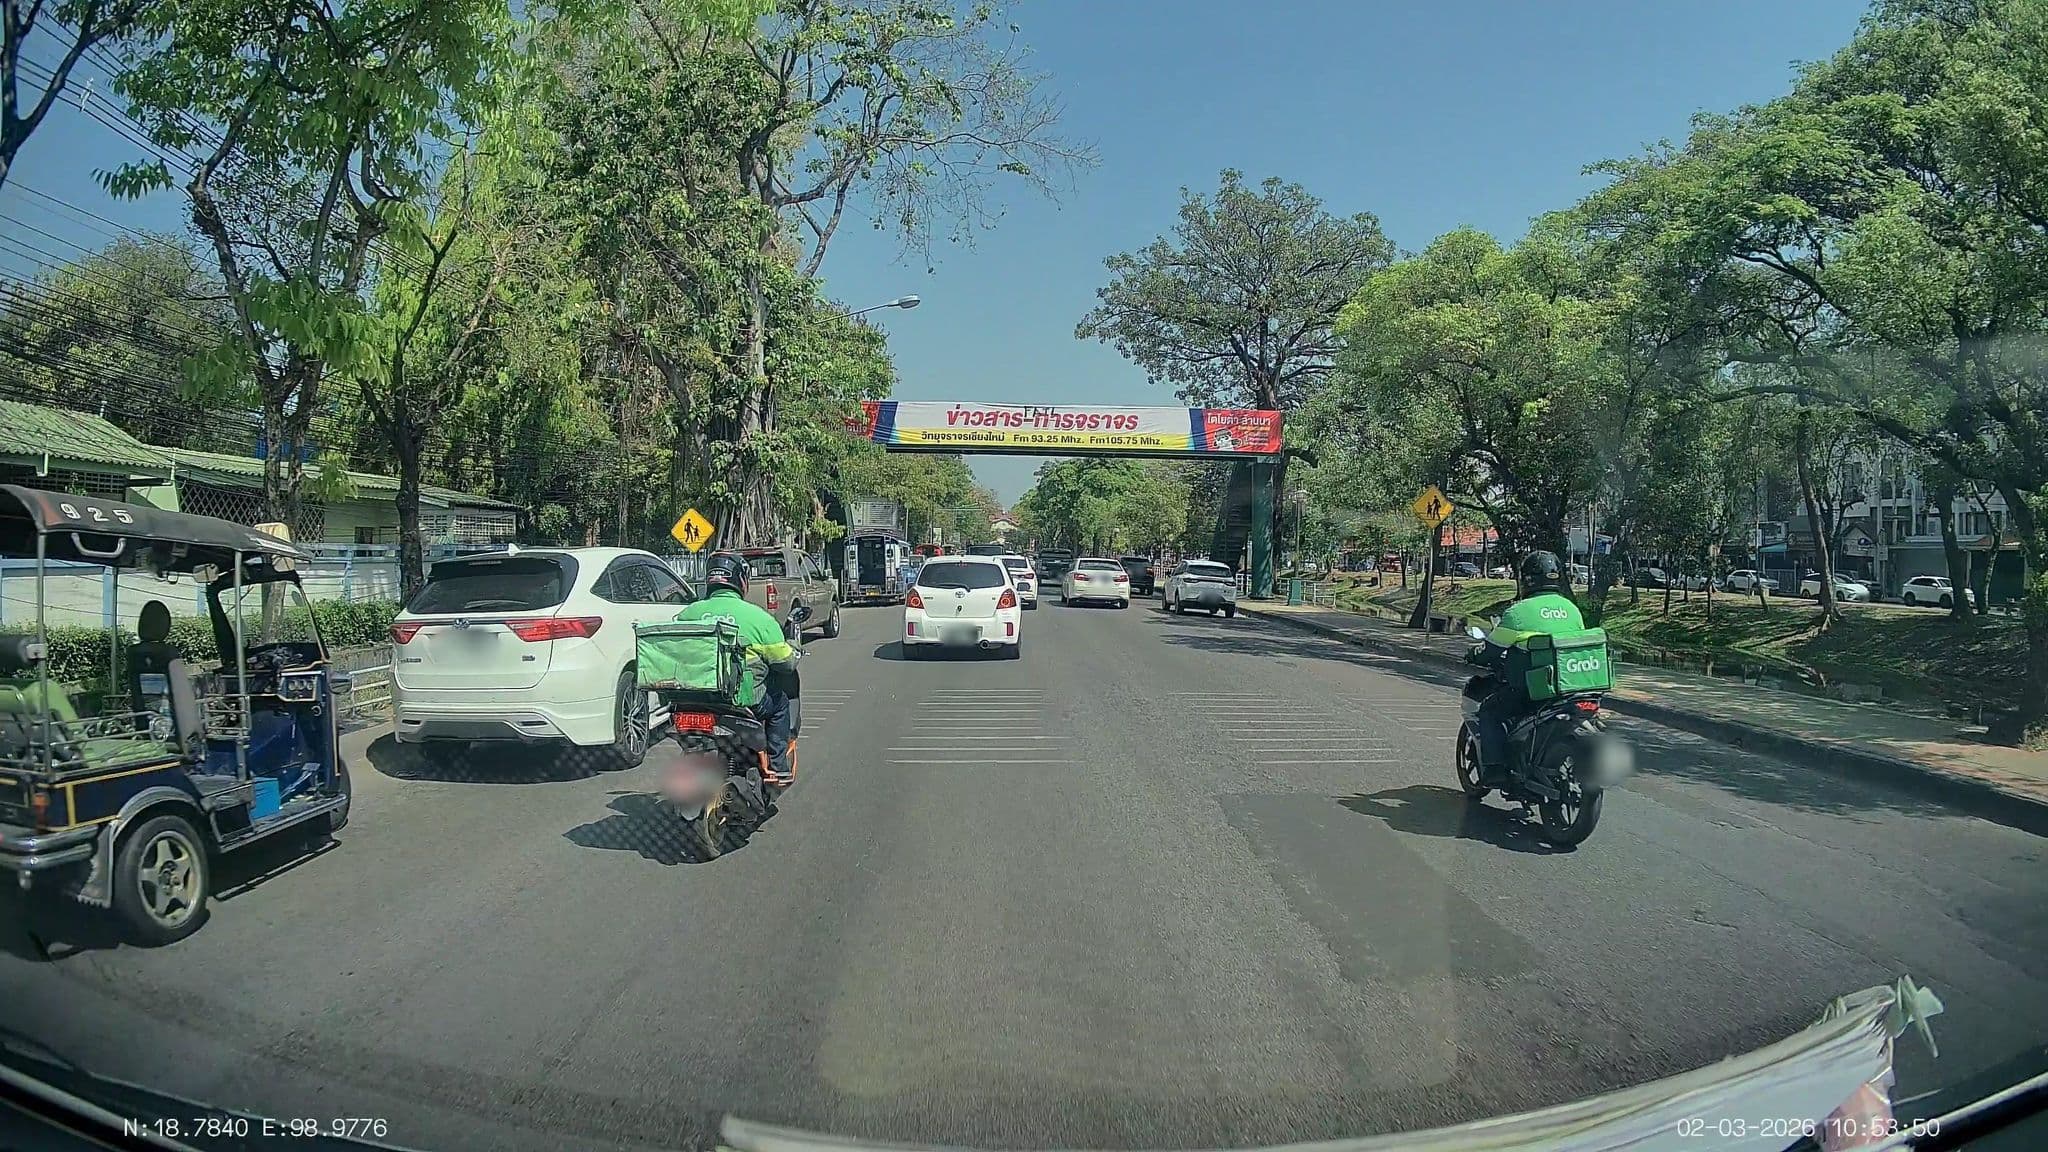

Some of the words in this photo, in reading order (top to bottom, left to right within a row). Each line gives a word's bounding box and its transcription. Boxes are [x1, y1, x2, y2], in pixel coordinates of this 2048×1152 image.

[1013, 434, 1029, 443] Fm
[1031, 434, 1059, 444] 93.25
[1061, 435, 1085, 444] Mhz.
[1140, 436, 1164, 446] Mhz.
[60, 503, 134, 524] 925
[1540, 606, 1568, 619] Grab
[1566, 656, 1601, 673] Grab
